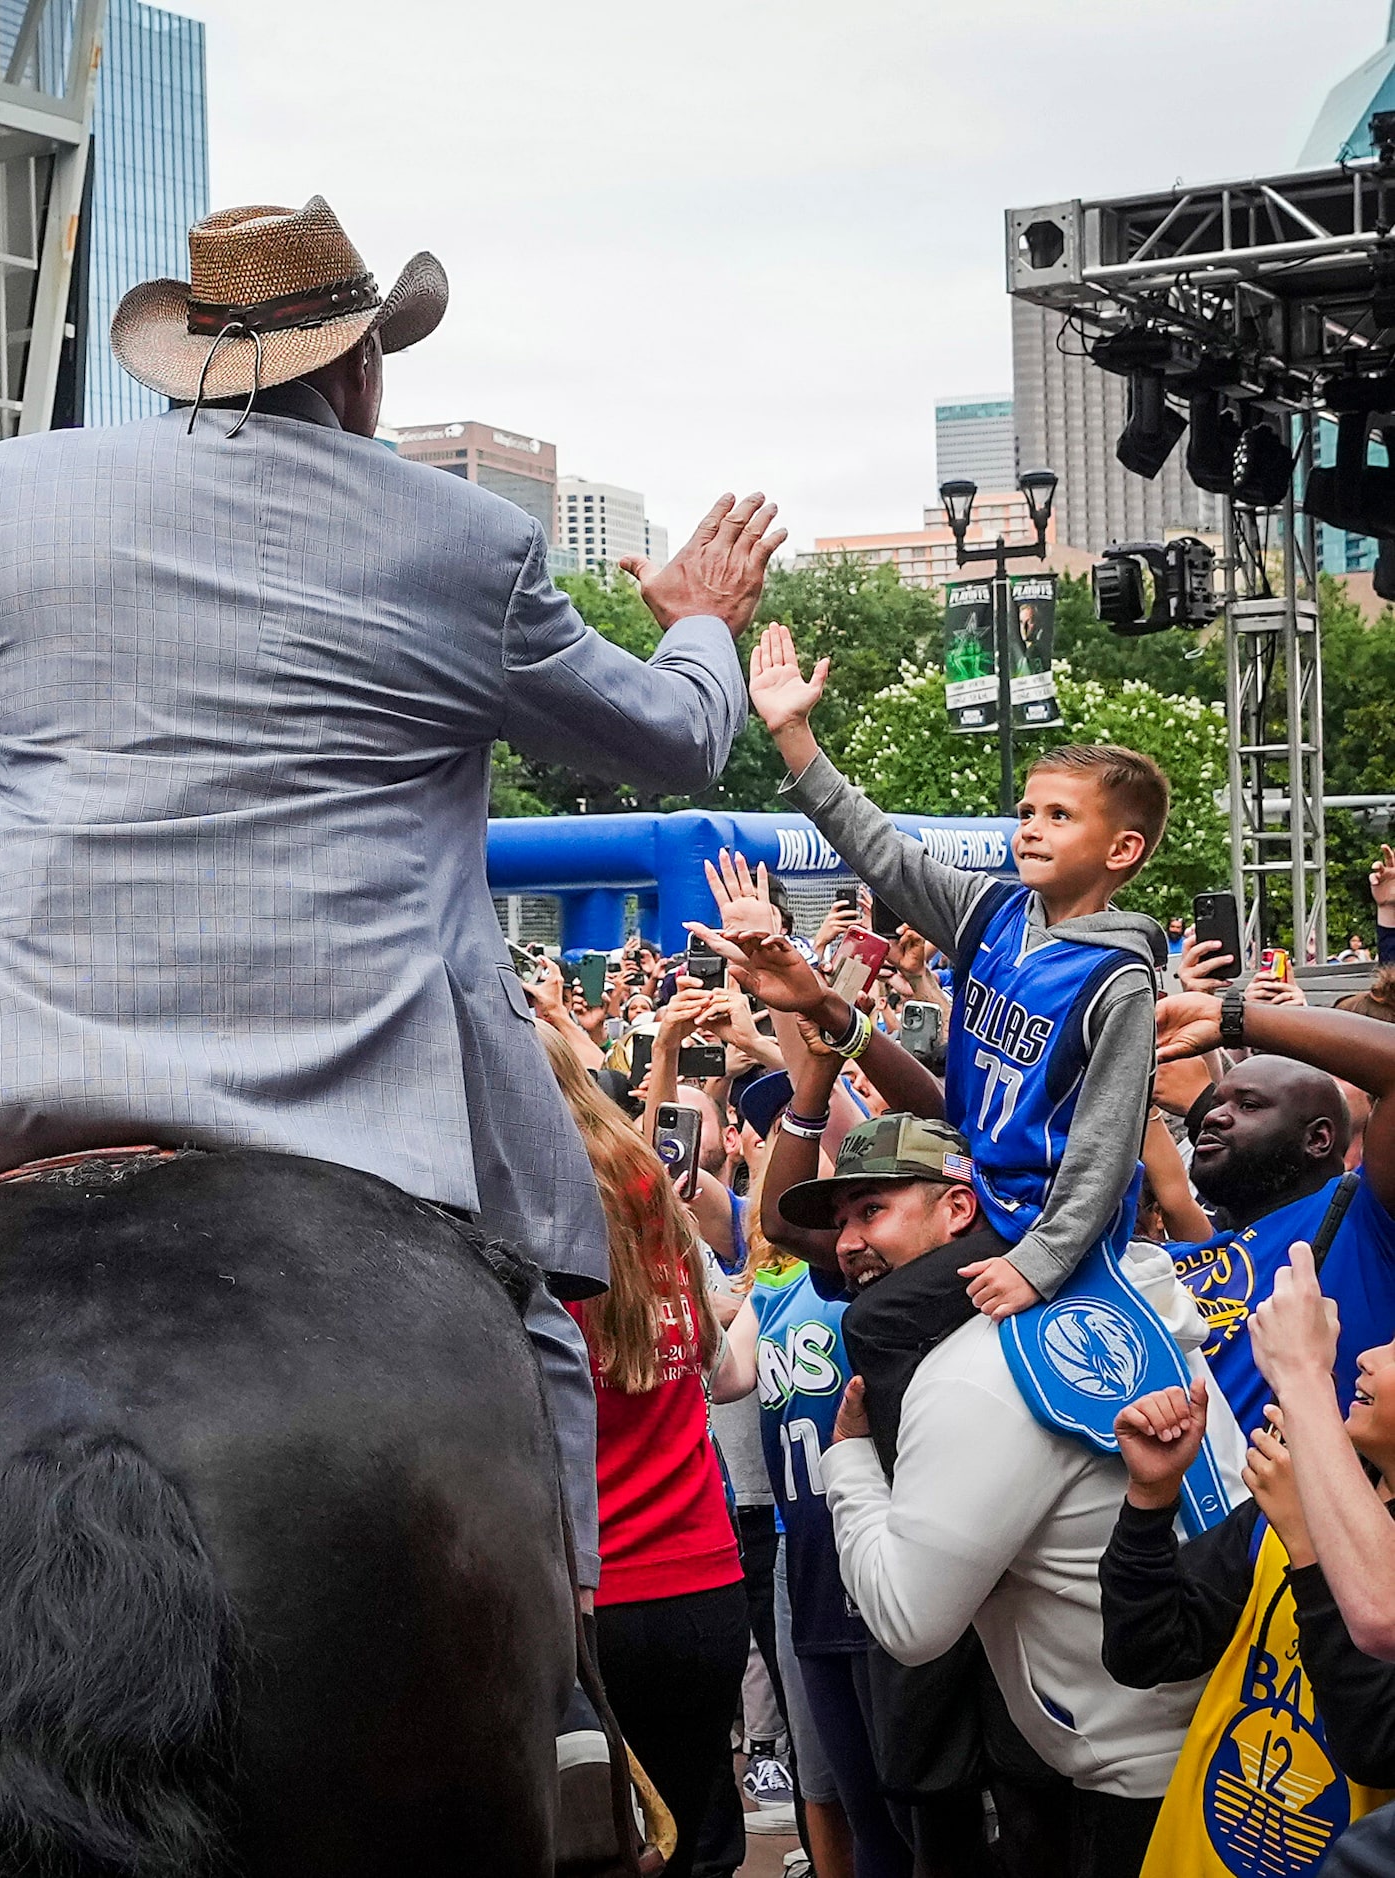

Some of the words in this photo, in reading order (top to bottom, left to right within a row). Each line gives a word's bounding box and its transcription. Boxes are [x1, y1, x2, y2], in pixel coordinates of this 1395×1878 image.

[919, 827, 1007, 868] MAVERICKS
[964, 972, 1054, 1067] ALLAS
[974, 1048, 1024, 1144] 77
[1174, 1247, 1227, 1276] OLDE
[757, 1320, 841, 1410] AVS
[1240, 1644, 1302, 1734] BA
[1257, 1730, 1293, 1804] 12
